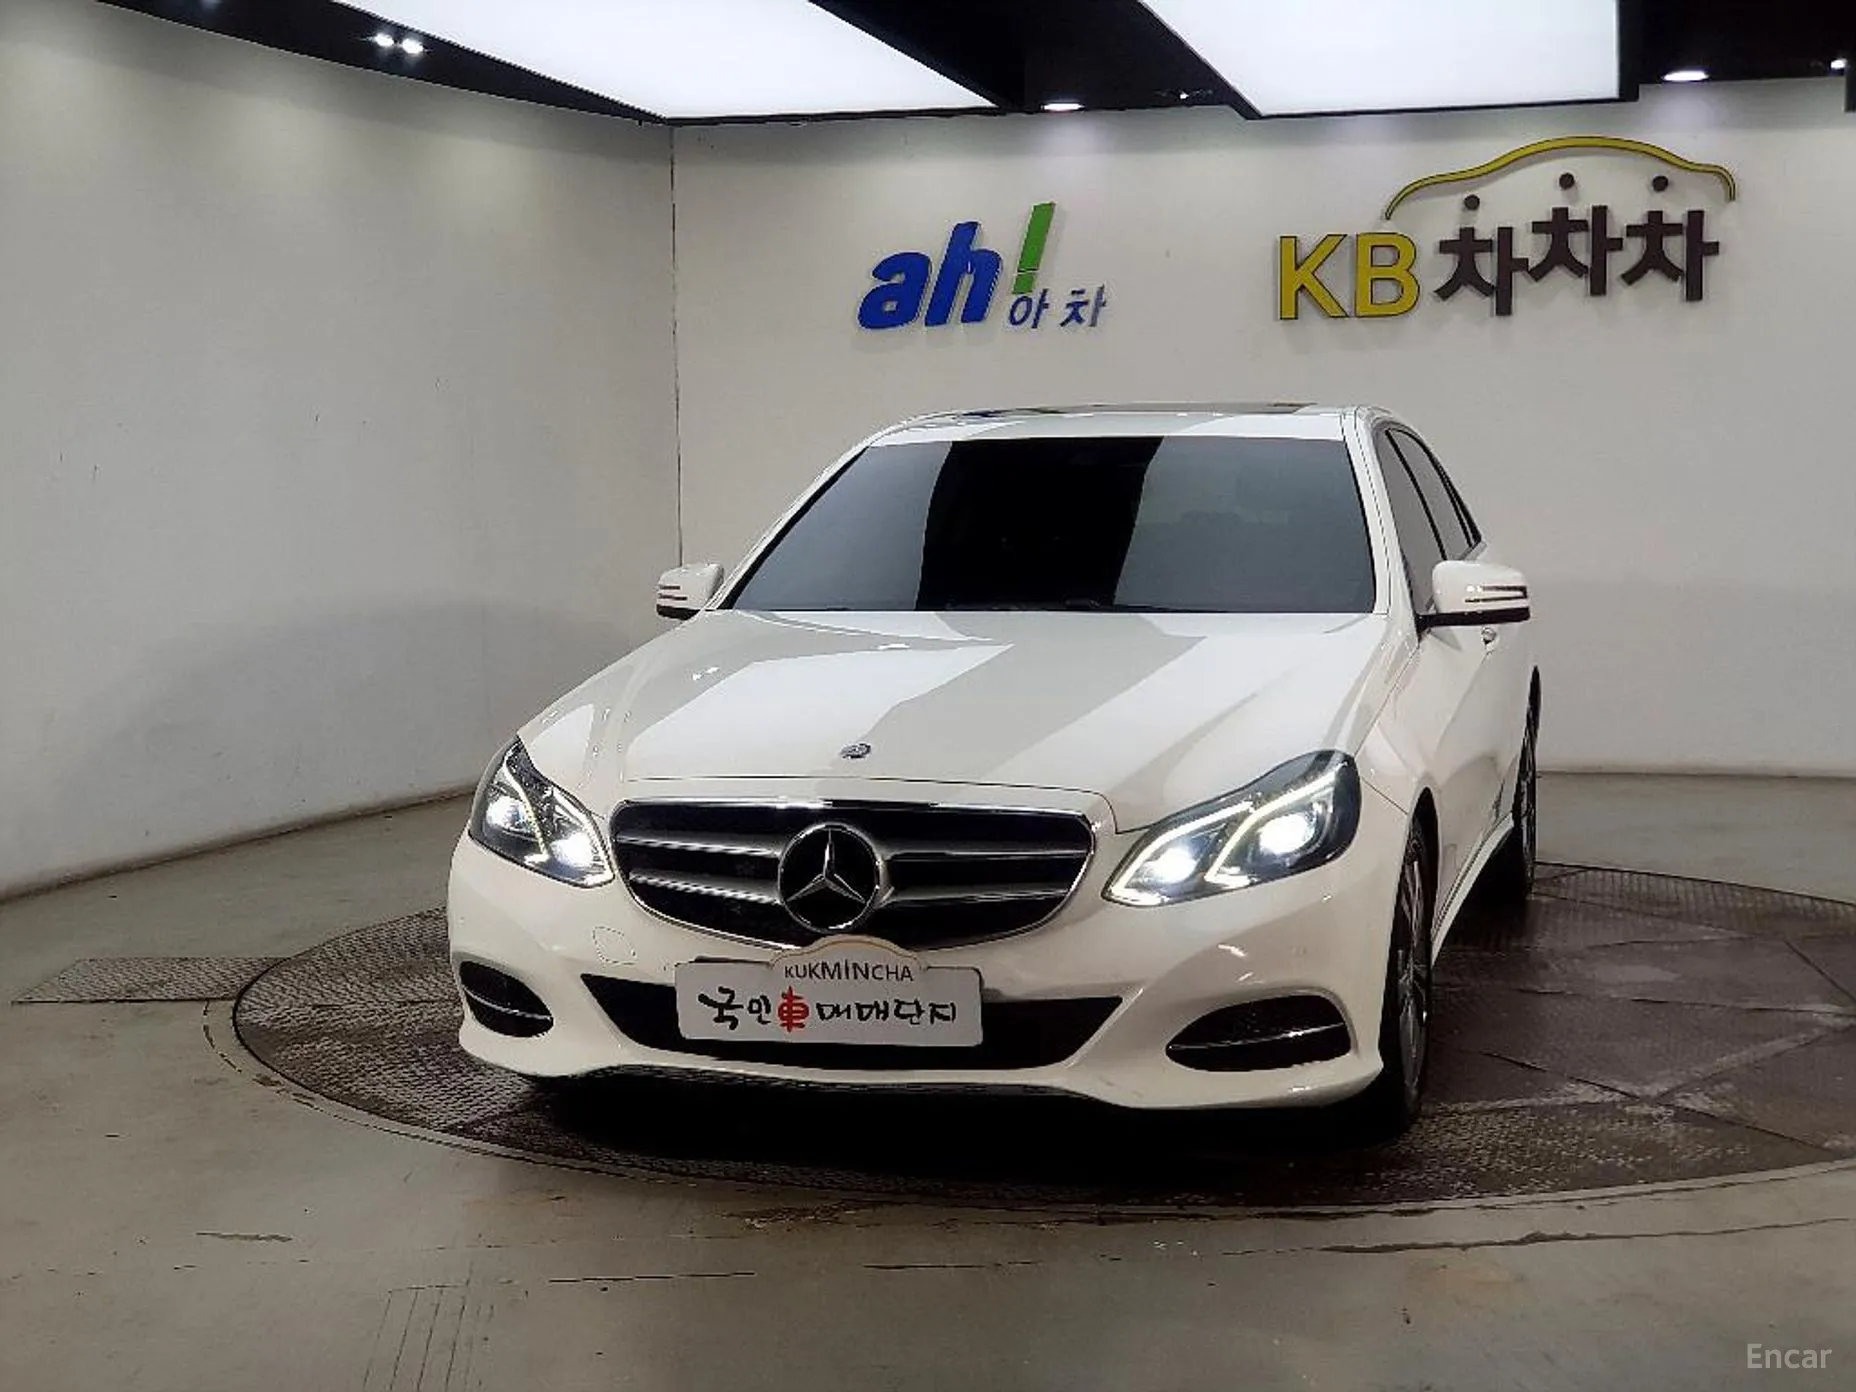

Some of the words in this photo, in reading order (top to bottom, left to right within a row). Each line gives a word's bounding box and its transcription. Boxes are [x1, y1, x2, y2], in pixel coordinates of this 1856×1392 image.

[1279, 232, 1420, 320] KB
[1434, 172, 1720, 316] 차차차
[1009, 285, 1106, 328] 아차
[784, 959, 915, 982] KUKMINCHA
